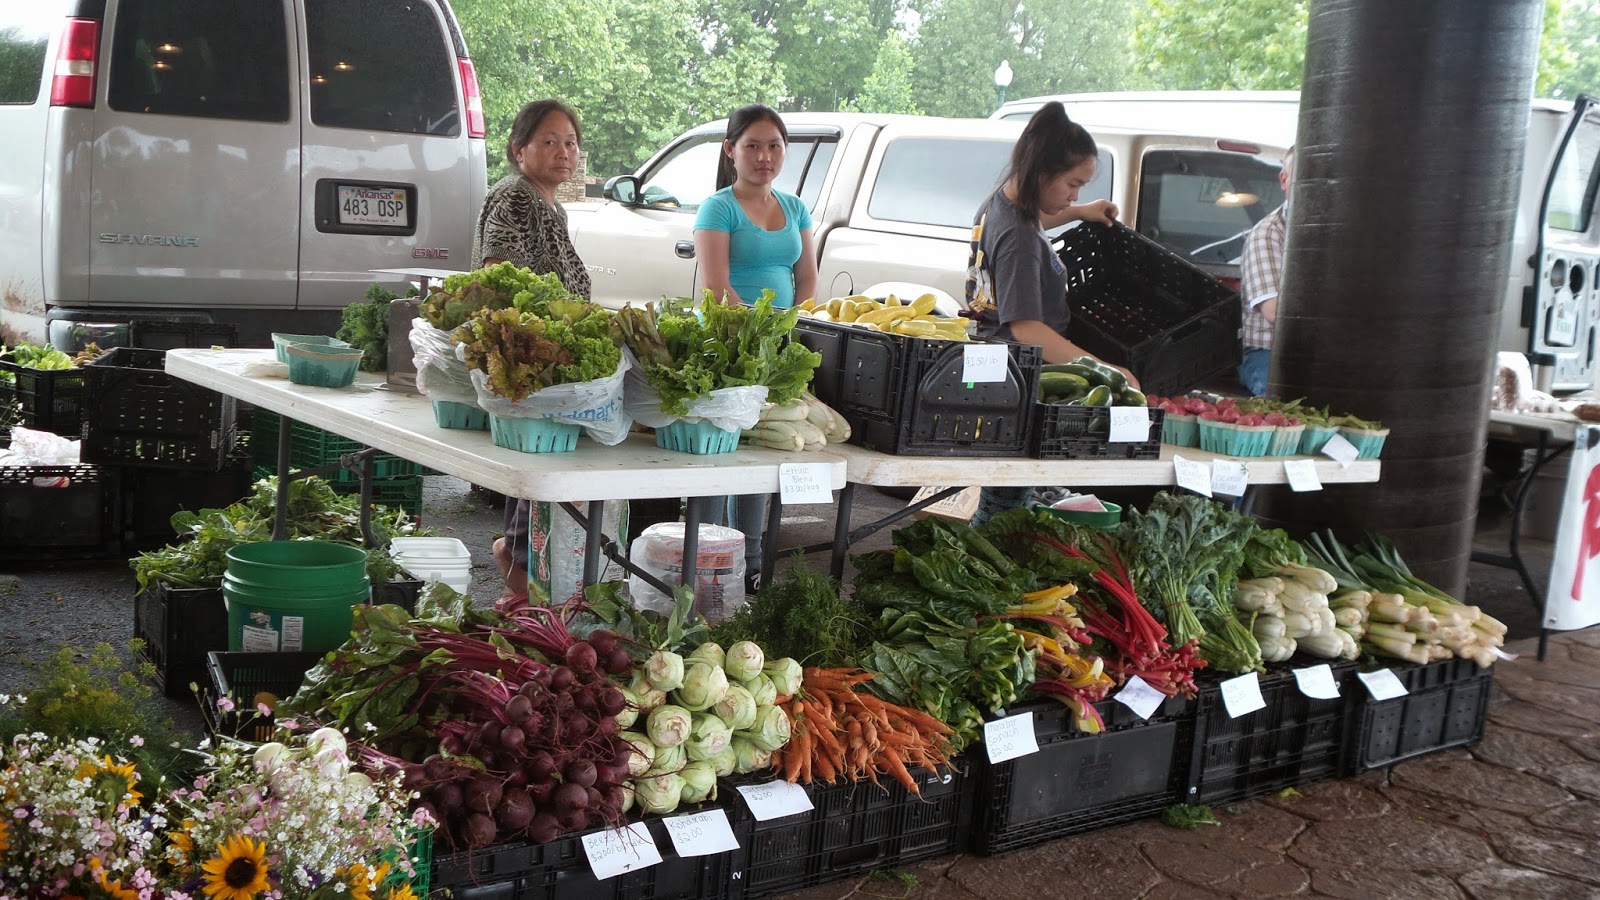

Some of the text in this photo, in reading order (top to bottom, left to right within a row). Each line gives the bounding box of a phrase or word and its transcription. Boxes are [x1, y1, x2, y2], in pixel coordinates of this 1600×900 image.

[355, 188, 392, 200] Arkansas
[343, 199, 369, 216] 483
[100, 232, 199, 248] SAVANA
[412, 247, 449, 259] GMC
